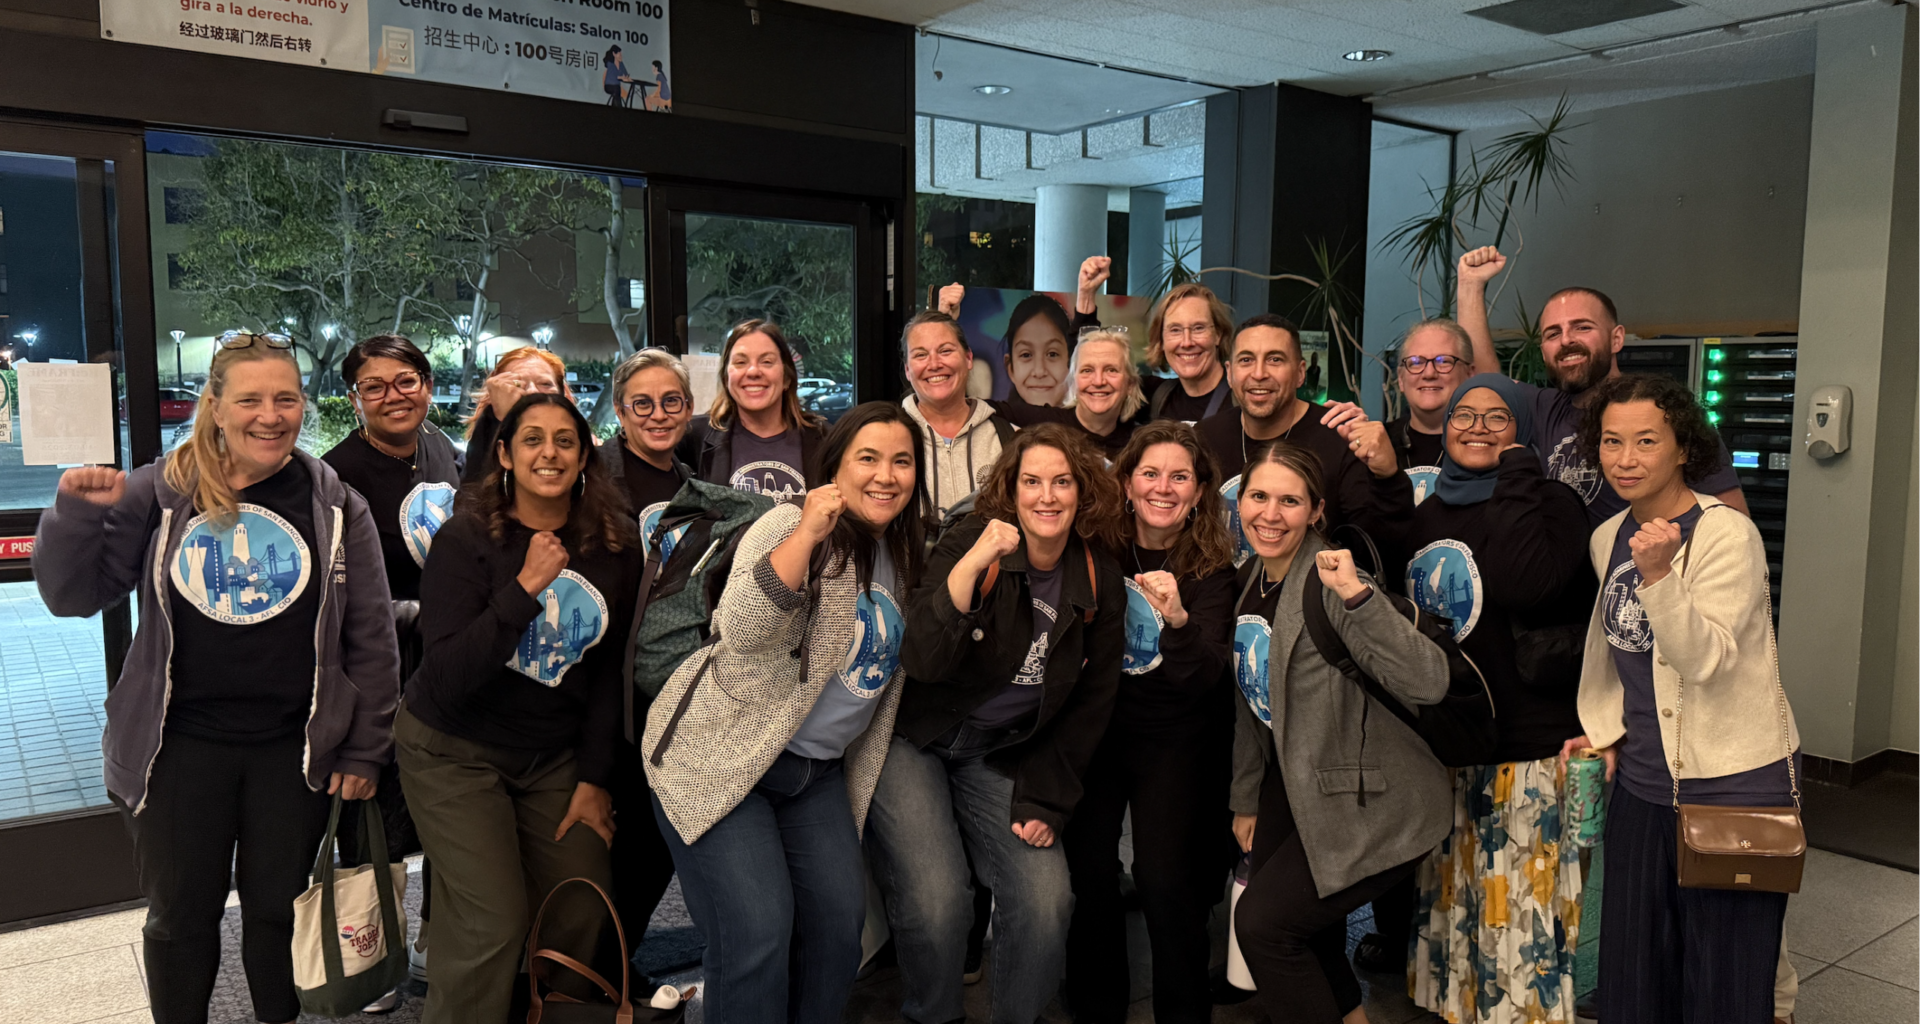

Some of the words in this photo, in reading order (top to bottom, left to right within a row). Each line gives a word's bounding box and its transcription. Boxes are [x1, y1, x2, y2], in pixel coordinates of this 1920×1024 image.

[180, 0, 211, 11] gira
[216, 3, 225, 13] a
[229, 2, 243, 16] la
[247, 6, 313, 26] derecha.
[340, 2, 349, 14] y
[635, 0, 663, 19] 100
[179, 20, 313, 53] 经过玻璃门然后右转
[462, 3, 483, 18] de
[488, 6, 576, 34] Matrículas:
[580, 22, 621, 41] Salon
[625, 30, 649, 46] 100
[252, 505, 264, 514] OF
[263, 510, 280, 522] SAN
[278, 519, 306, 551] FRANCISCO
[11, 542, 33, 553] PUS
[570, 572, 584, 584] SAN
[582, 581, 607, 615] FRANCISCO
[197, 602, 217, 618] AFSA
[219, 613, 247, 623] LOCAL
[261, 611, 275, 620] AFL
[277, 597, 292, 610] CIO
